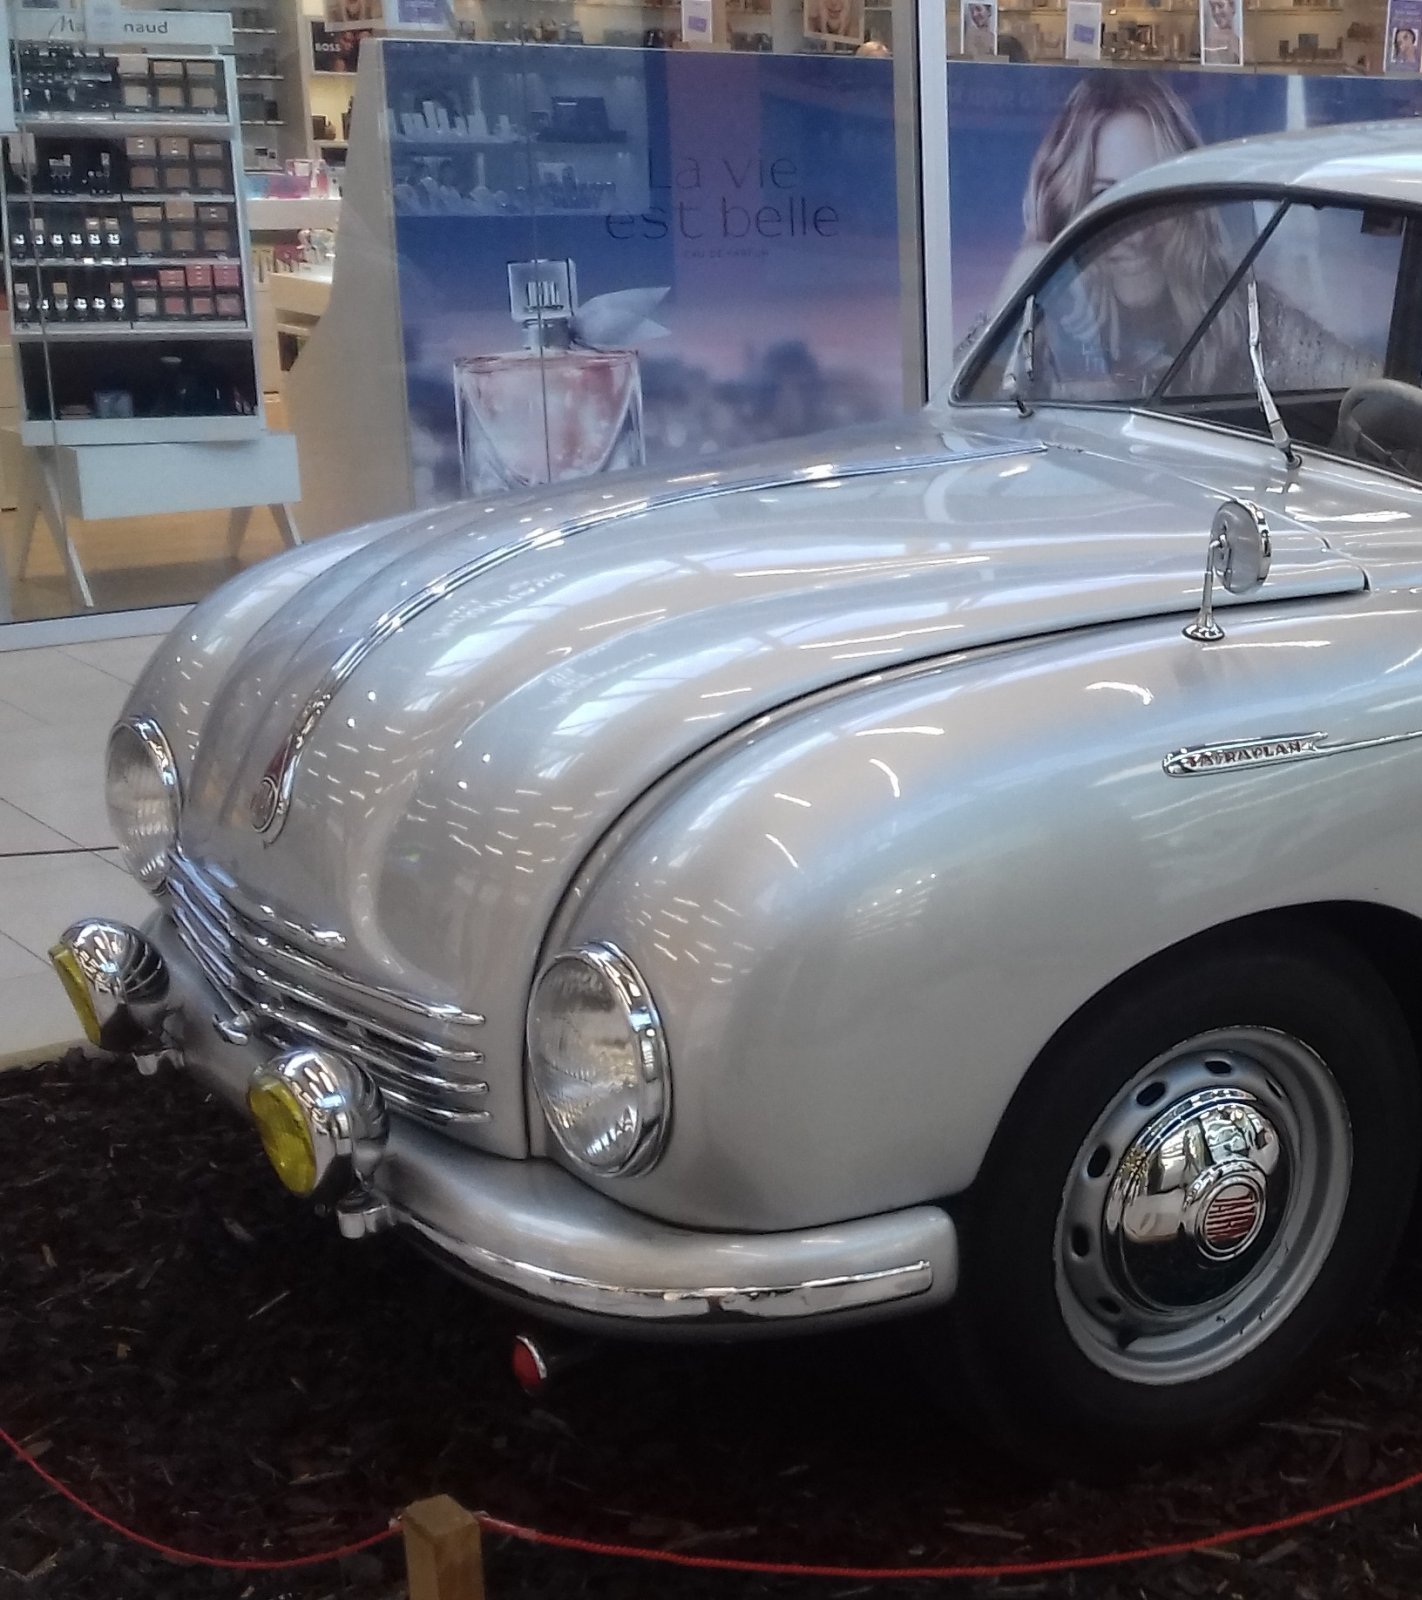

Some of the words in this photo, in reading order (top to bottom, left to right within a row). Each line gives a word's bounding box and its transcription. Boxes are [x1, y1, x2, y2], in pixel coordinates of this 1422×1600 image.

[315, 42, 342, 52] BOSS
[648, 150, 701, 189] La
[721, 151, 798, 189] vie
[605, 200, 704, 240] est
[721, 196, 840, 238] belle
[1186, 741, 1302, 767] TATRAPLAN
